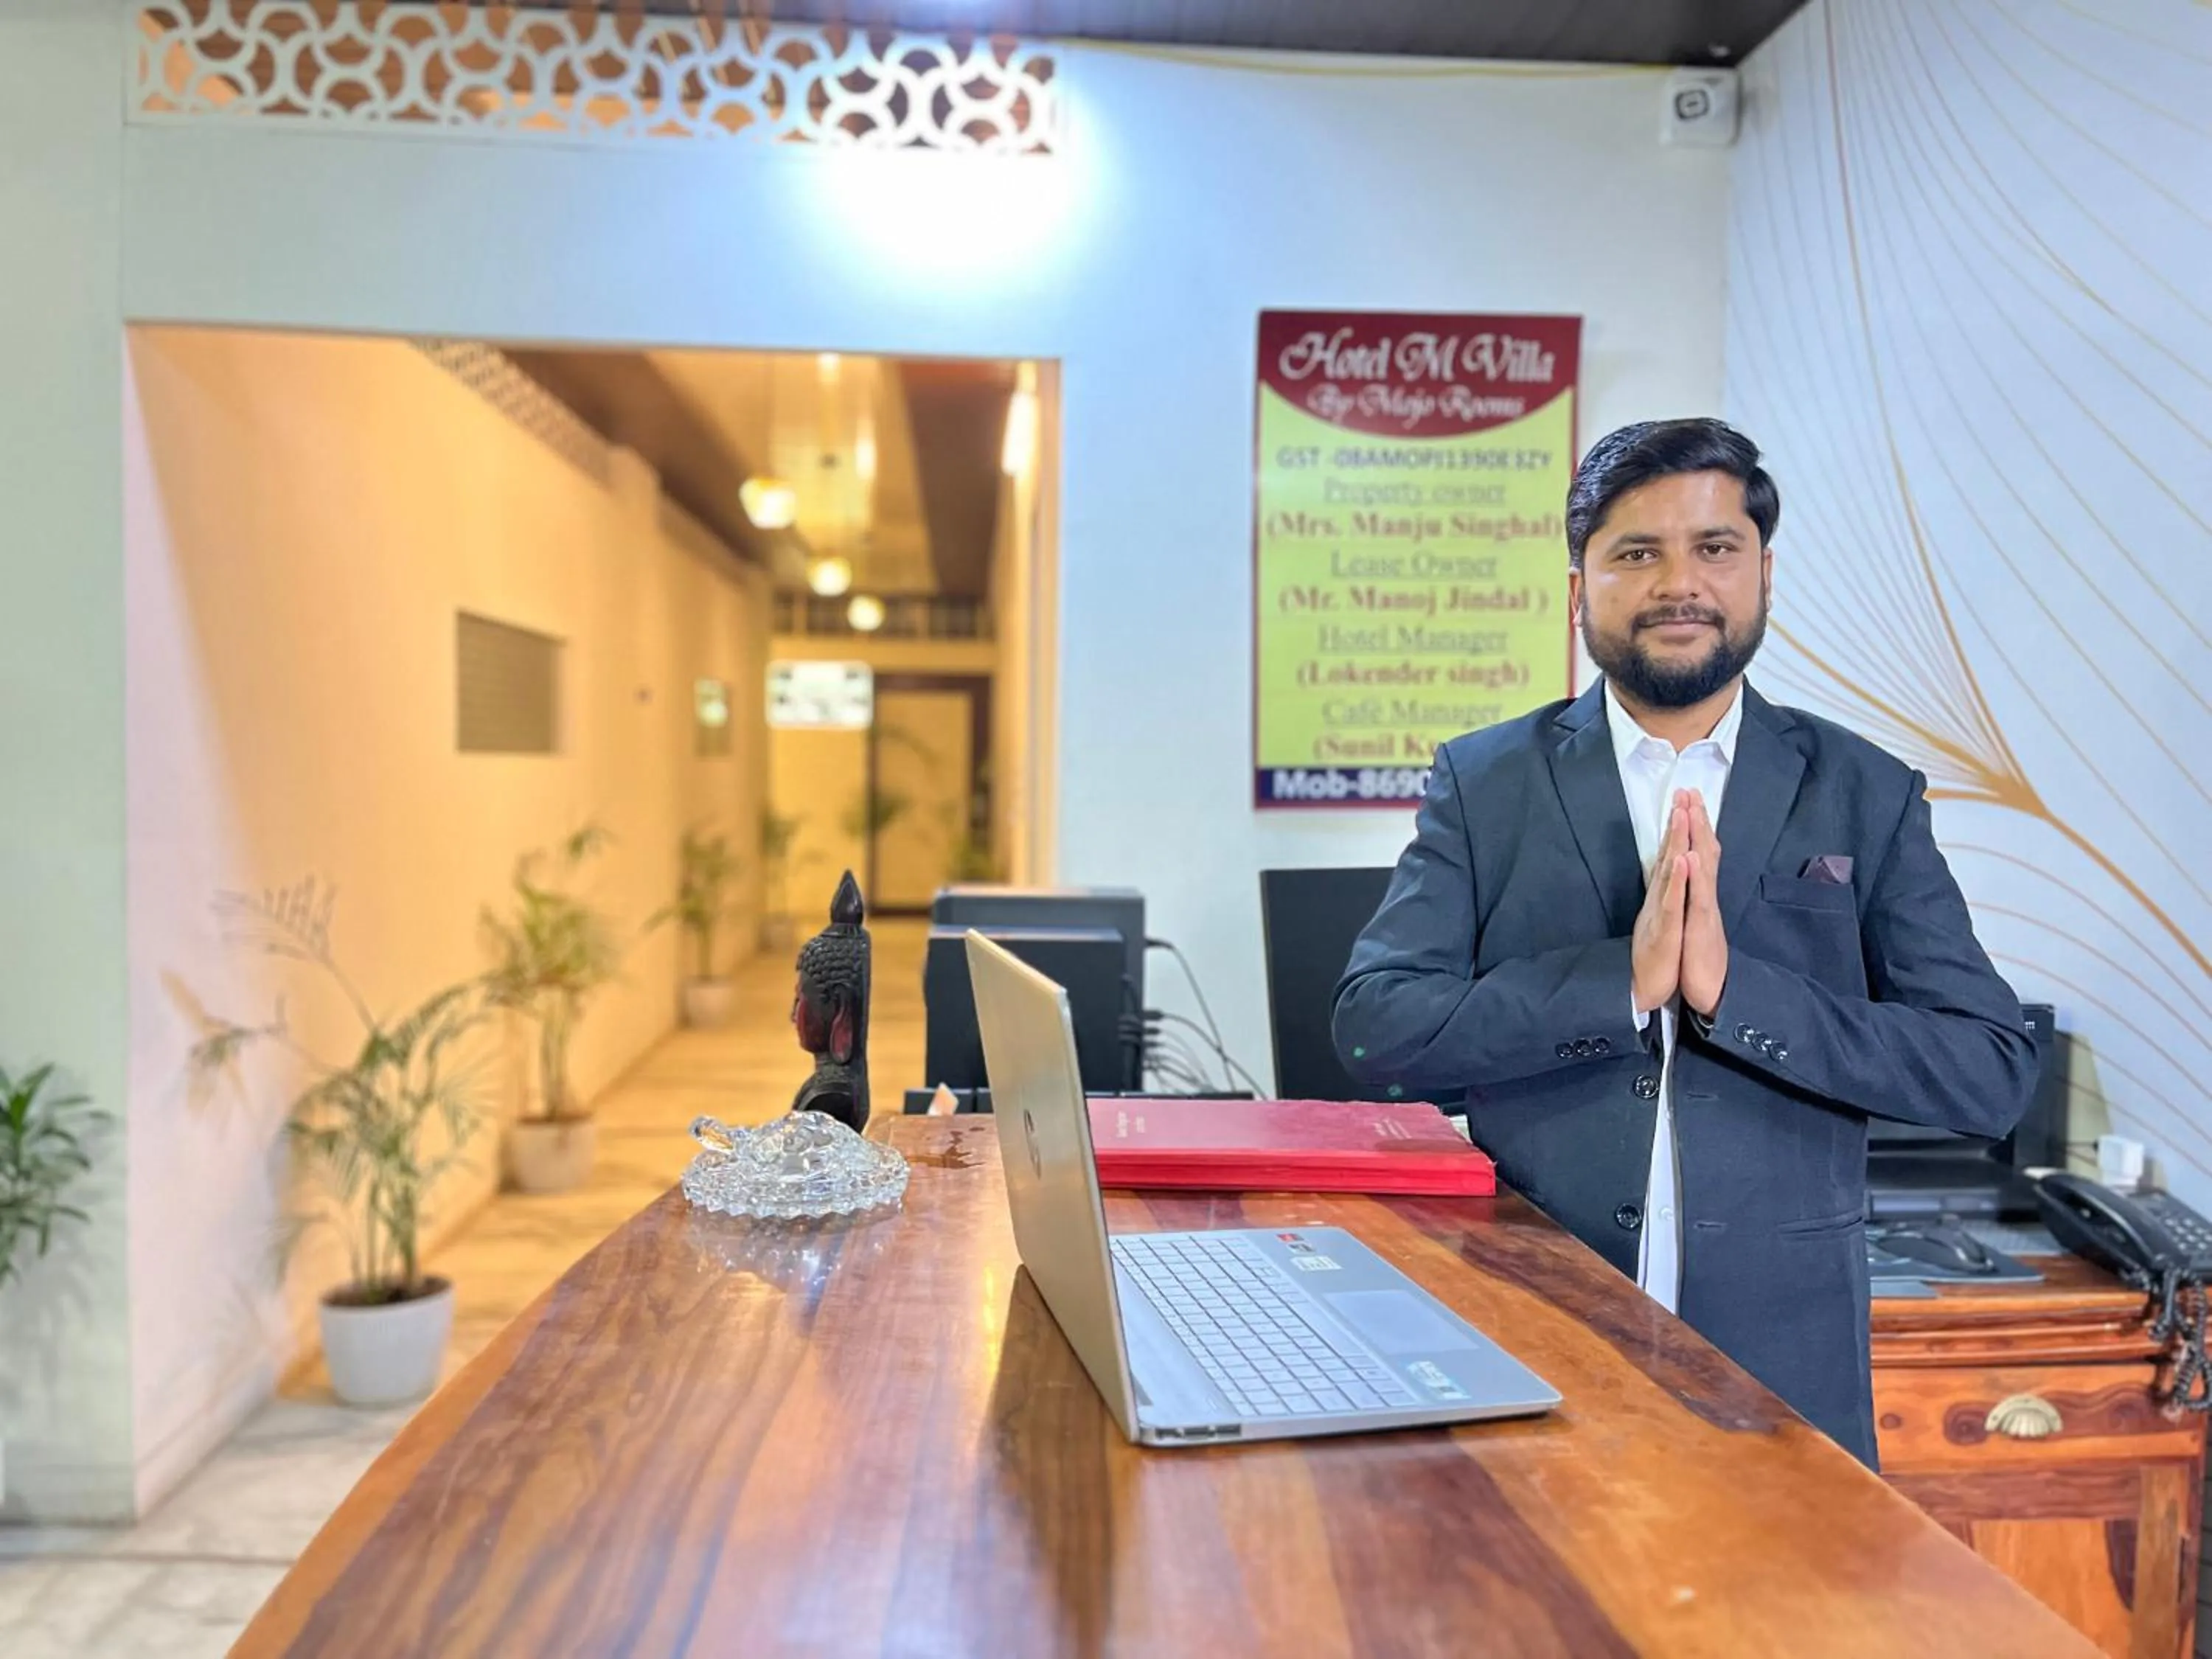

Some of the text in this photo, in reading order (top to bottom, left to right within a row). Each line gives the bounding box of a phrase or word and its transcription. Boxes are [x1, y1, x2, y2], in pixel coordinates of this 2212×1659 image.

[1279, 327, 1556, 383] Hotel M Villa
[1307, 383, 1353, 422] By
[1439, 384, 1526, 422] Rooms
[1276, 447, 1320, 468] GST
[1352, 512, 1442, 543] Manju
[1331, 549, 1498, 578] Lease Owner
[1350, 585, 1437, 616] Manoj
[1318, 623, 1510, 657] Hotel Manager
[1404, 734, 1436, 759] K
